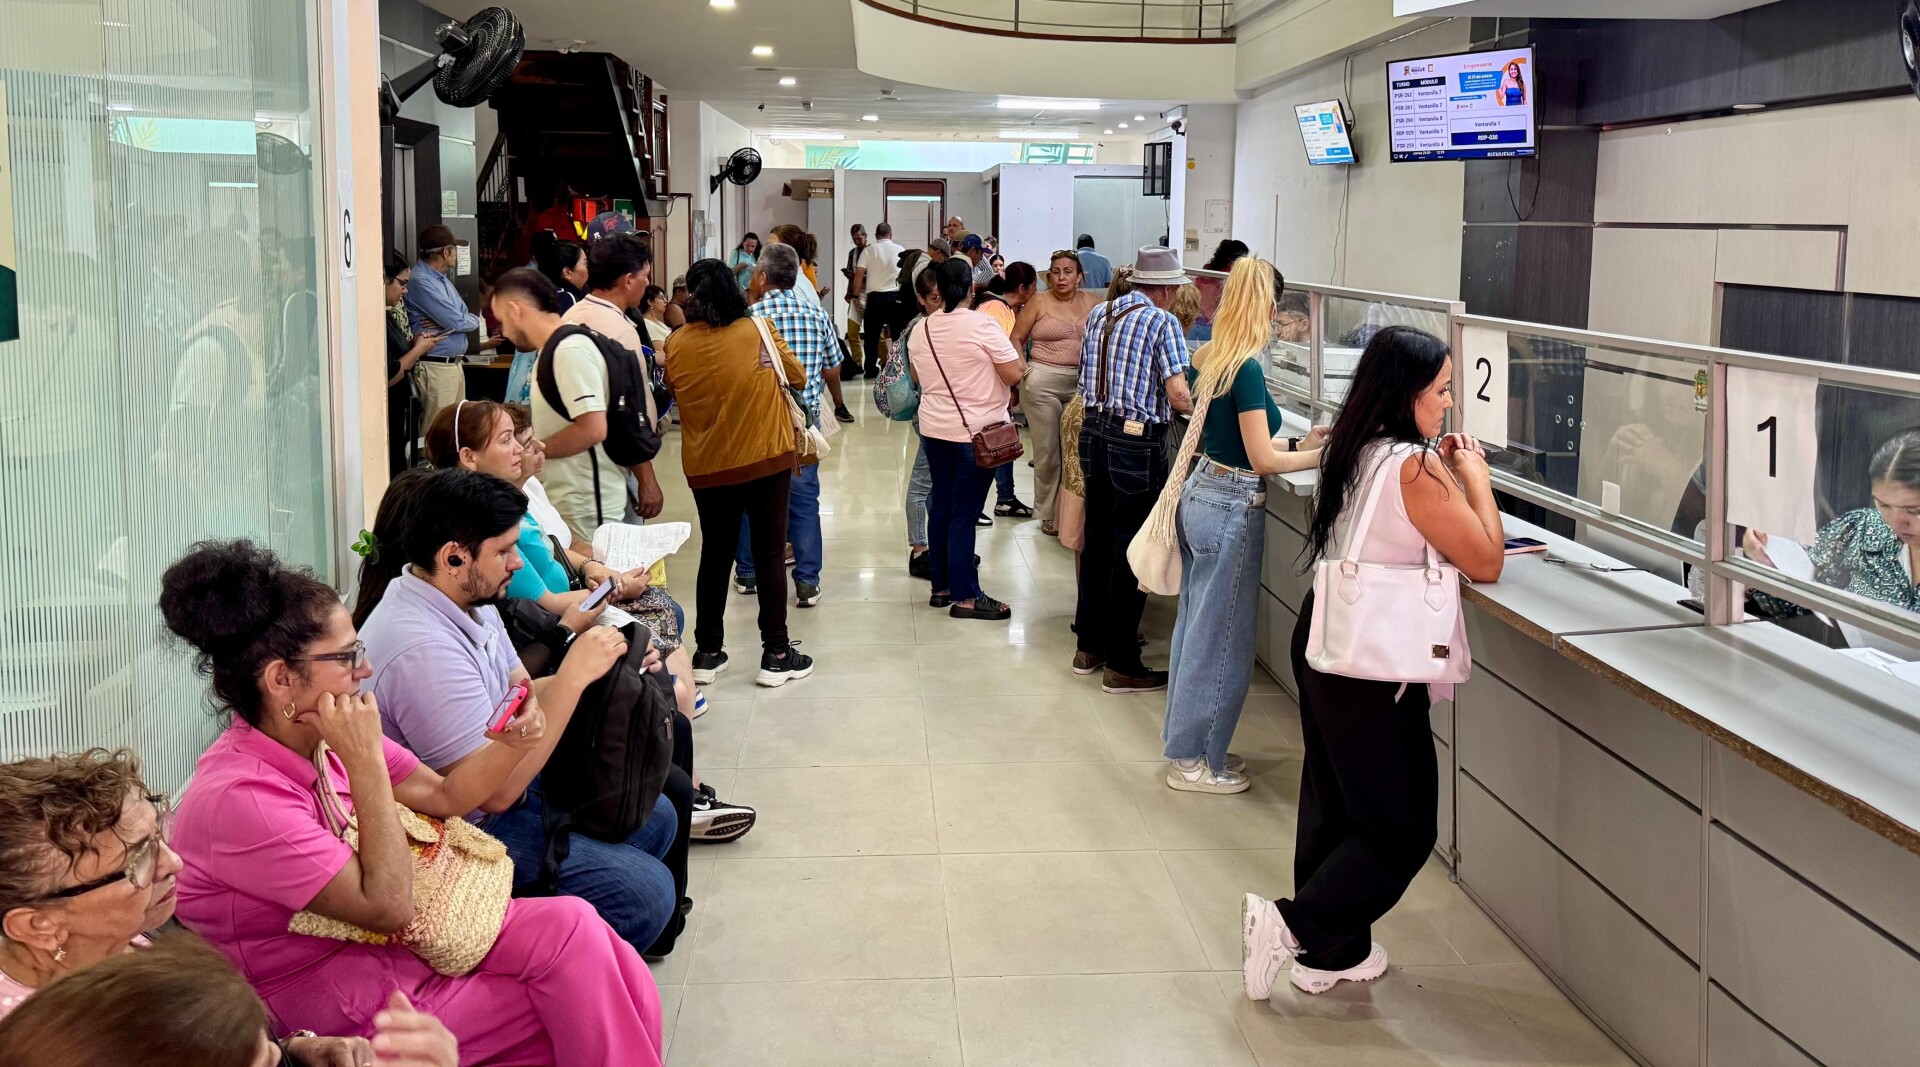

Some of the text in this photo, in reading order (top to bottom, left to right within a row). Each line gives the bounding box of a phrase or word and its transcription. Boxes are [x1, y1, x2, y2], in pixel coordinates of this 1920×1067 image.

[343, 208, 352, 268] 6
[1476, 357, 1492, 402] 2
[1757, 416, 1777, 478] 1
